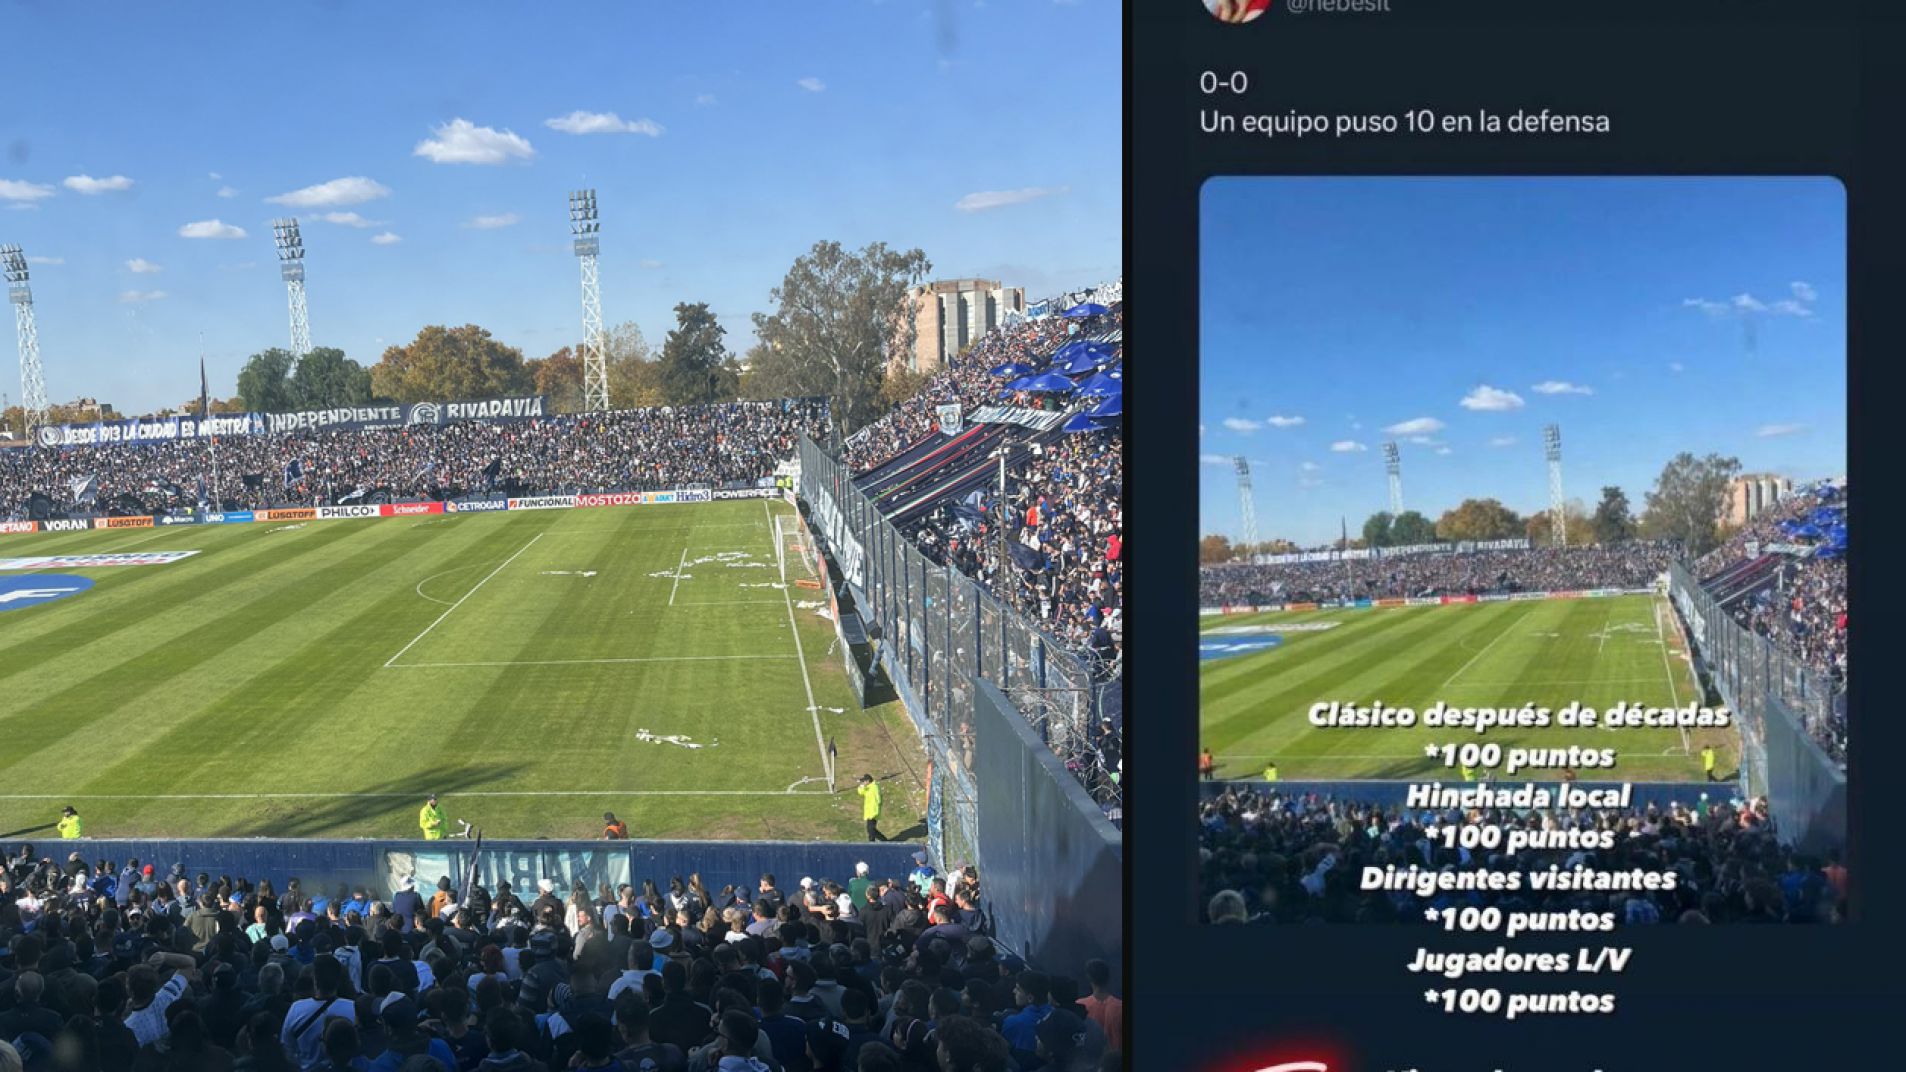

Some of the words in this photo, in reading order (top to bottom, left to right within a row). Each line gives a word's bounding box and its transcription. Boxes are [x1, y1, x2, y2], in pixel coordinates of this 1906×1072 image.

[1200, 71, 1248, 93] 0-0
[1200, 110, 1235, 132] Un
[1242, 109, 1329, 137] equipo
[1336, 115, 1397, 137] puso
[1404, 109, 1435, 132] 10
[1441, 115, 1471, 132] en
[1480, 109, 1500, 132] la
[1508, 109, 1610, 132] defensa
[447, 396, 543, 418] RIVADAVIA
[267, 405, 401, 432] INDEPENDIENTE
[64, 427, 97, 444] DESDE
[100, 425, 121, 442] 1913
[123, 424, 137, 440] LA
[138, 422, 176, 440] CIUDAD
[181, 421, 195, 437] ES
[199, 418, 250, 437] NUESTRA
[457, 500, 506, 512] CETROGAR
[519, 497, 572, 508] FUNCIONAL
[44, 519, 89, 532] VORAN
[205, 514, 225, 523] UNO
